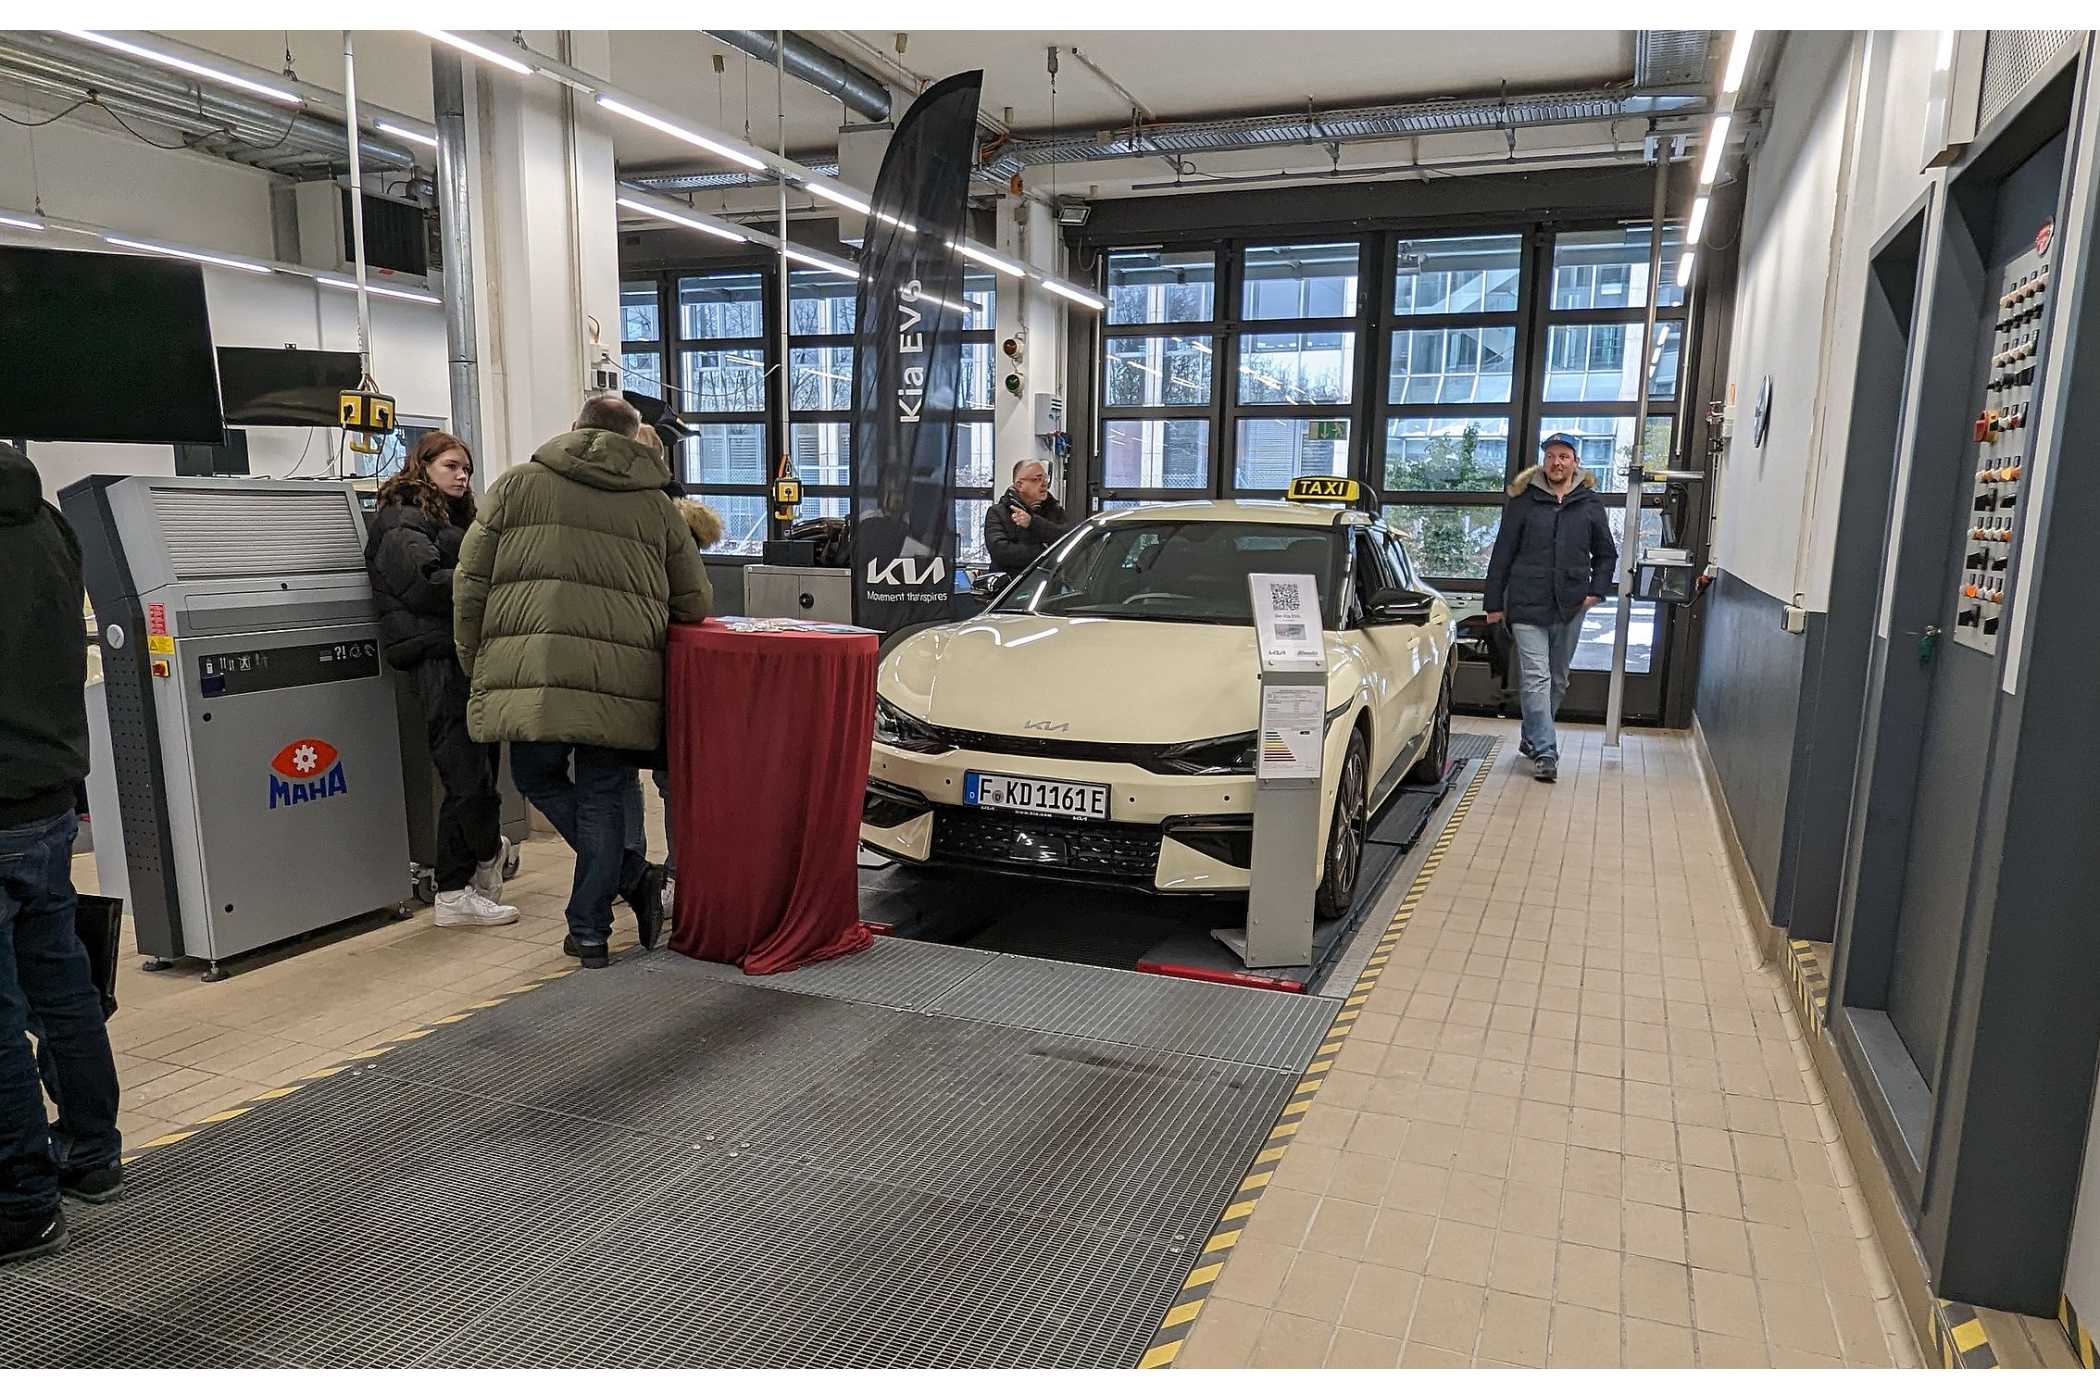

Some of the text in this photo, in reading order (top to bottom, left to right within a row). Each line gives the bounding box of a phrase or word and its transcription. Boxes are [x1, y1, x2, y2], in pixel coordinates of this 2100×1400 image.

[899, 367, 925, 423] Kia
[1300, 481, 1345, 495] TAXI
[867, 591, 905, 602] Movement
[269, 761, 347, 809] MAHA
